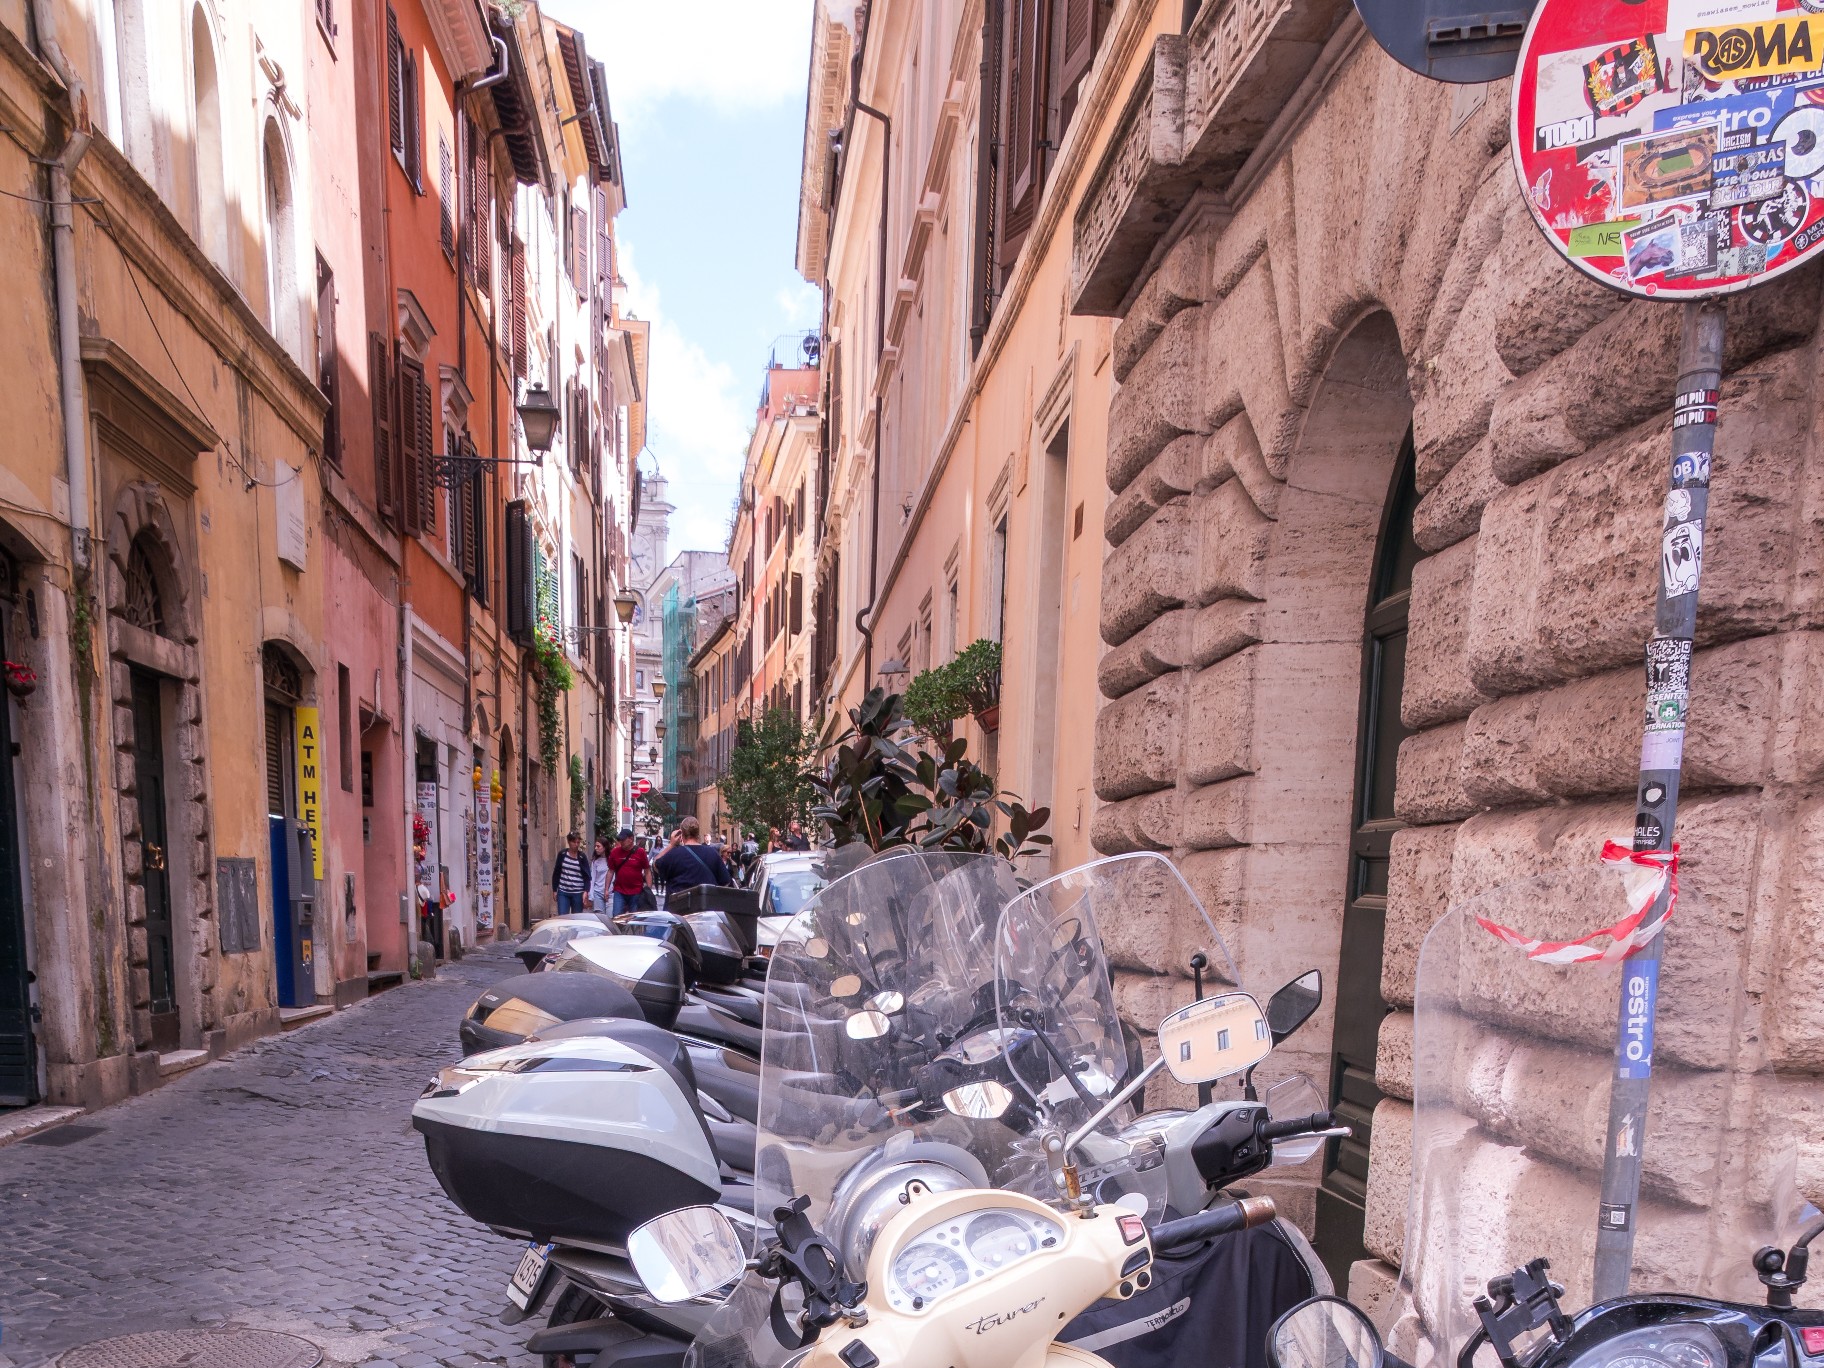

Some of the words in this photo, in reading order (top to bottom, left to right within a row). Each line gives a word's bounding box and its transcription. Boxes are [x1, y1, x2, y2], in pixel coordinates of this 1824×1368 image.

[1694, 20, 1813, 76] ROMA
[302, 726, 316, 778] ATM
[1626, 976, 1648, 1061] estro
